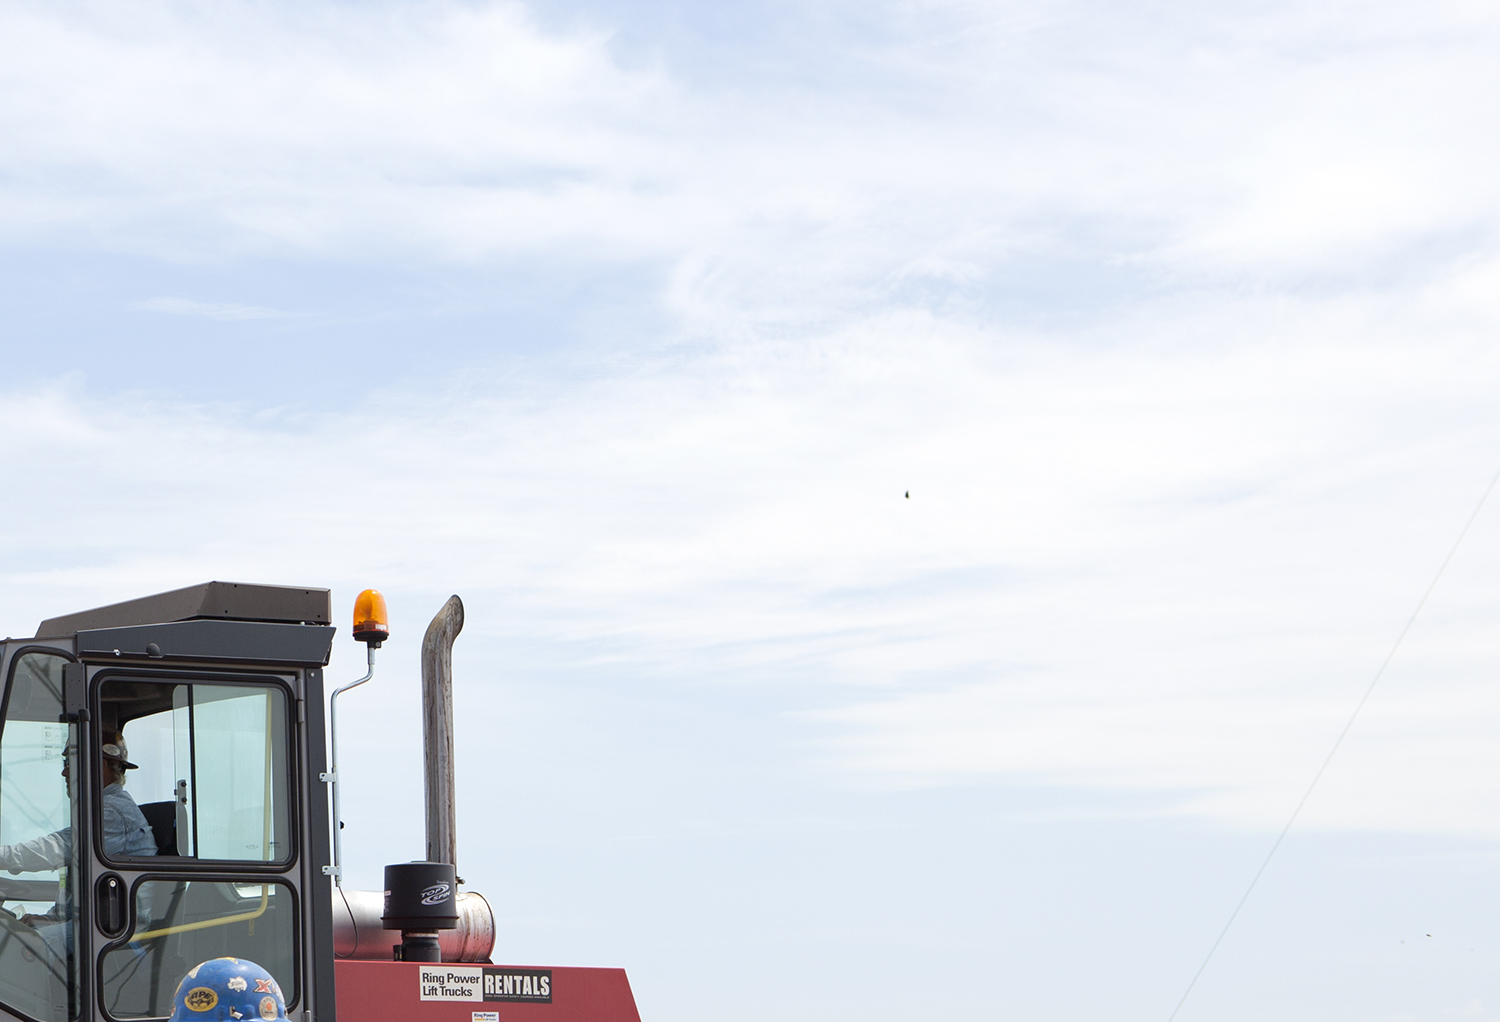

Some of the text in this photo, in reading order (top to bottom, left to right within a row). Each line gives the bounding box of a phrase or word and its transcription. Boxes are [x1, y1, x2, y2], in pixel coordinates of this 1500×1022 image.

[422, 973, 480, 985] Ring Power
[485, 975, 550, 995] RENTALS
[423, 986, 438, 996] Lift
[439, 986, 473, 997] Trucks
